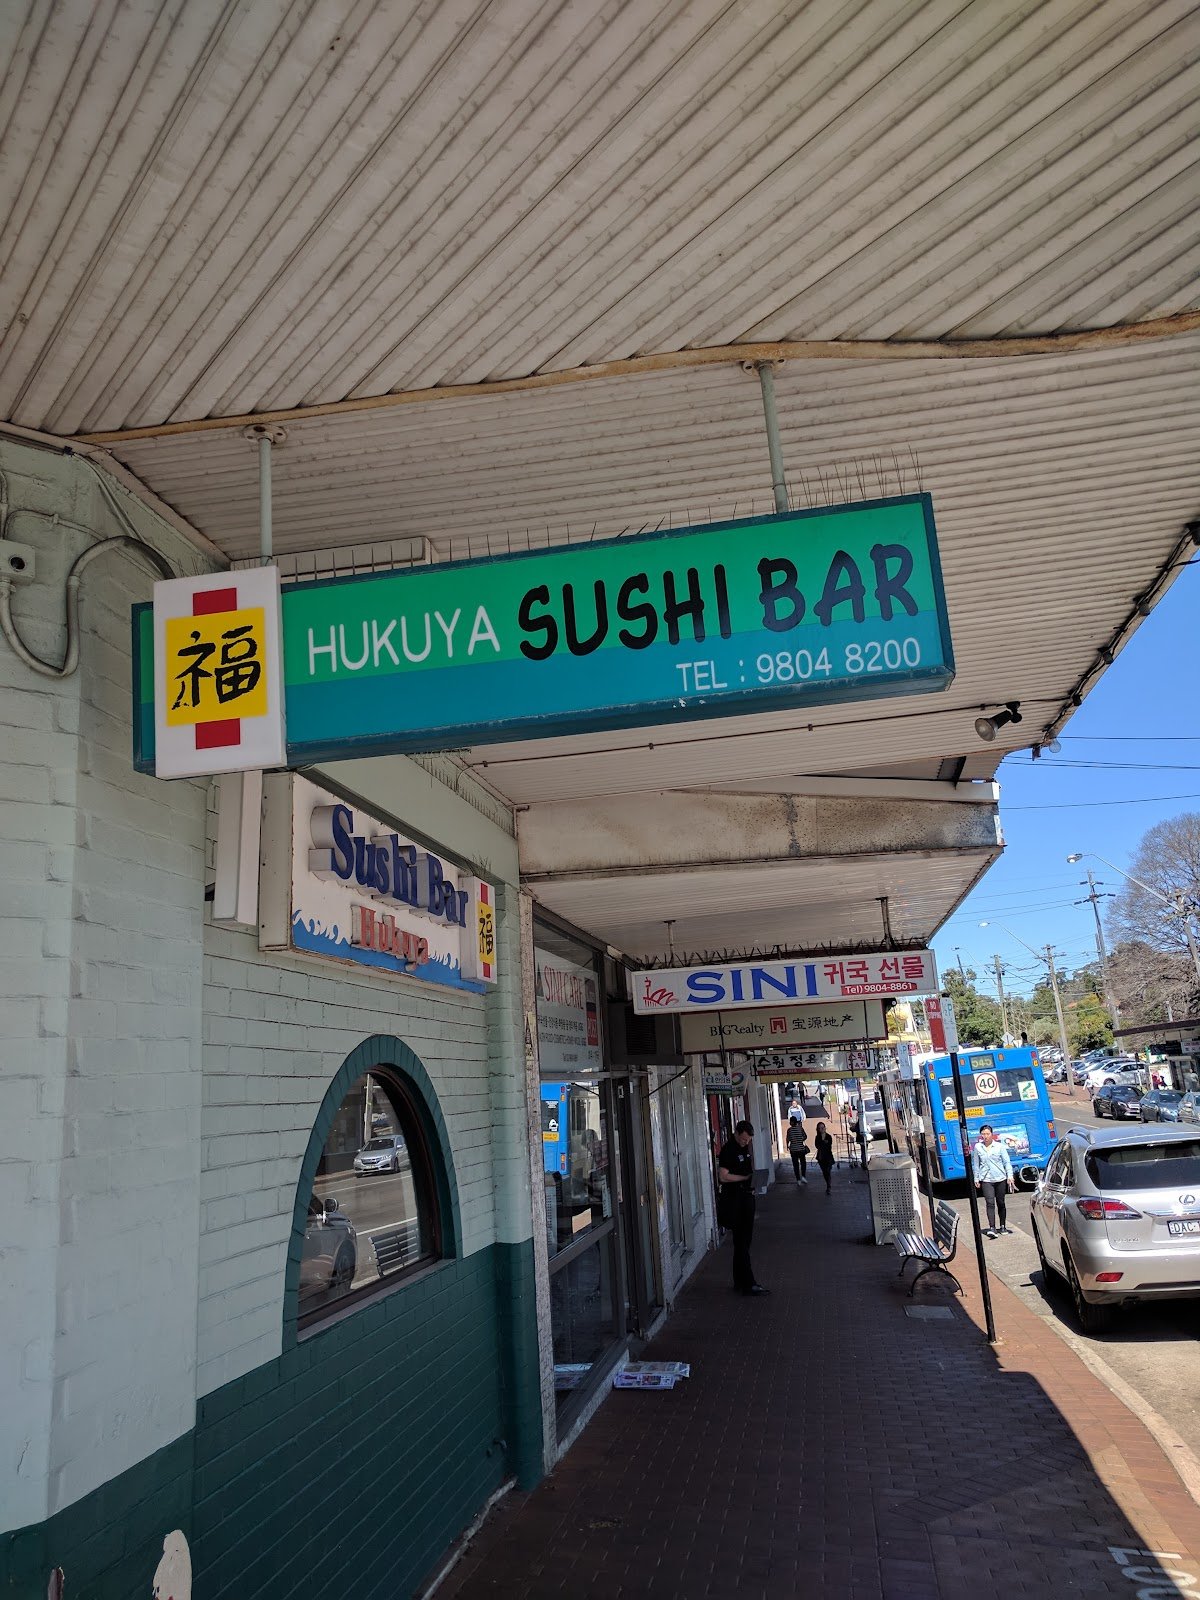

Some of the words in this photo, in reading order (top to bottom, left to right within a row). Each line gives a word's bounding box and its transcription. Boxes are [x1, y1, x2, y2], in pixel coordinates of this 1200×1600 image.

[308, 605, 500, 675] HUKUYA
[518, 563, 731, 661] SUSHI
[757, 543, 919, 632] BAR
[172, 625, 261, 711] 福
[676, 660, 728, 692] TEL
[756, 647, 832, 684] 9804
[845, 637, 921, 674] 8200
[331, 804, 419, 908] Sushi
[428, 853, 469, 928] Bar
[478, 908, 495, 956] 福
[686, 964, 819, 1003] SINI
[823, 960, 869, 985] 귀국
[878, 956, 924, 980] 선물
[792, 1013, 854, 1031] 宝源地产
[979, 1077, 995, 1089] 40
